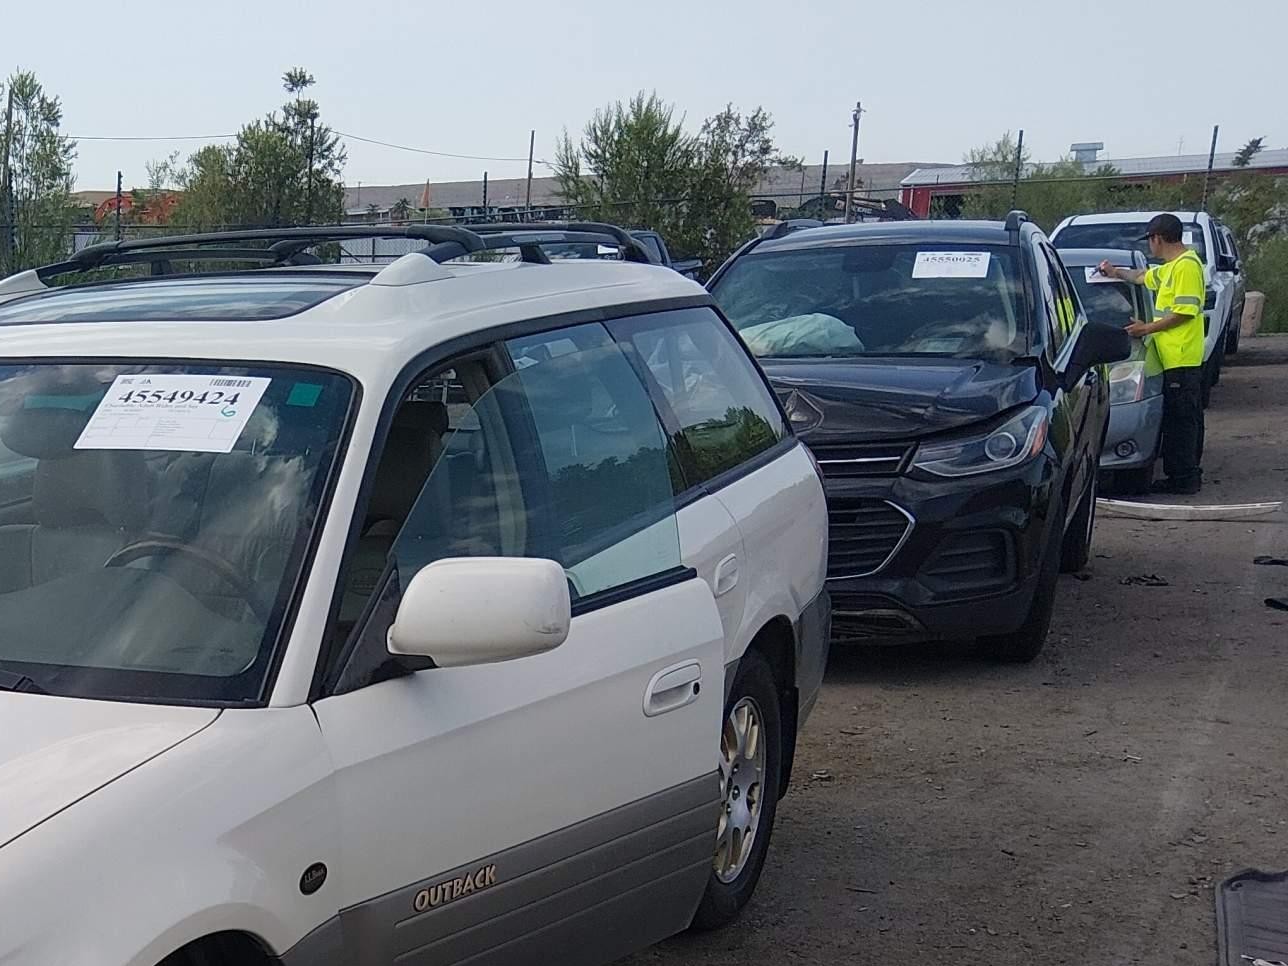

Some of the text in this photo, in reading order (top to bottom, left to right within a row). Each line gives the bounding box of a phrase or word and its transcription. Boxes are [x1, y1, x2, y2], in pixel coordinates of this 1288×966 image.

[118, 390, 240, 405] 45549424
[220, 406, 236, 417] 6
[414, 864, 496, 911] OUTBACK
